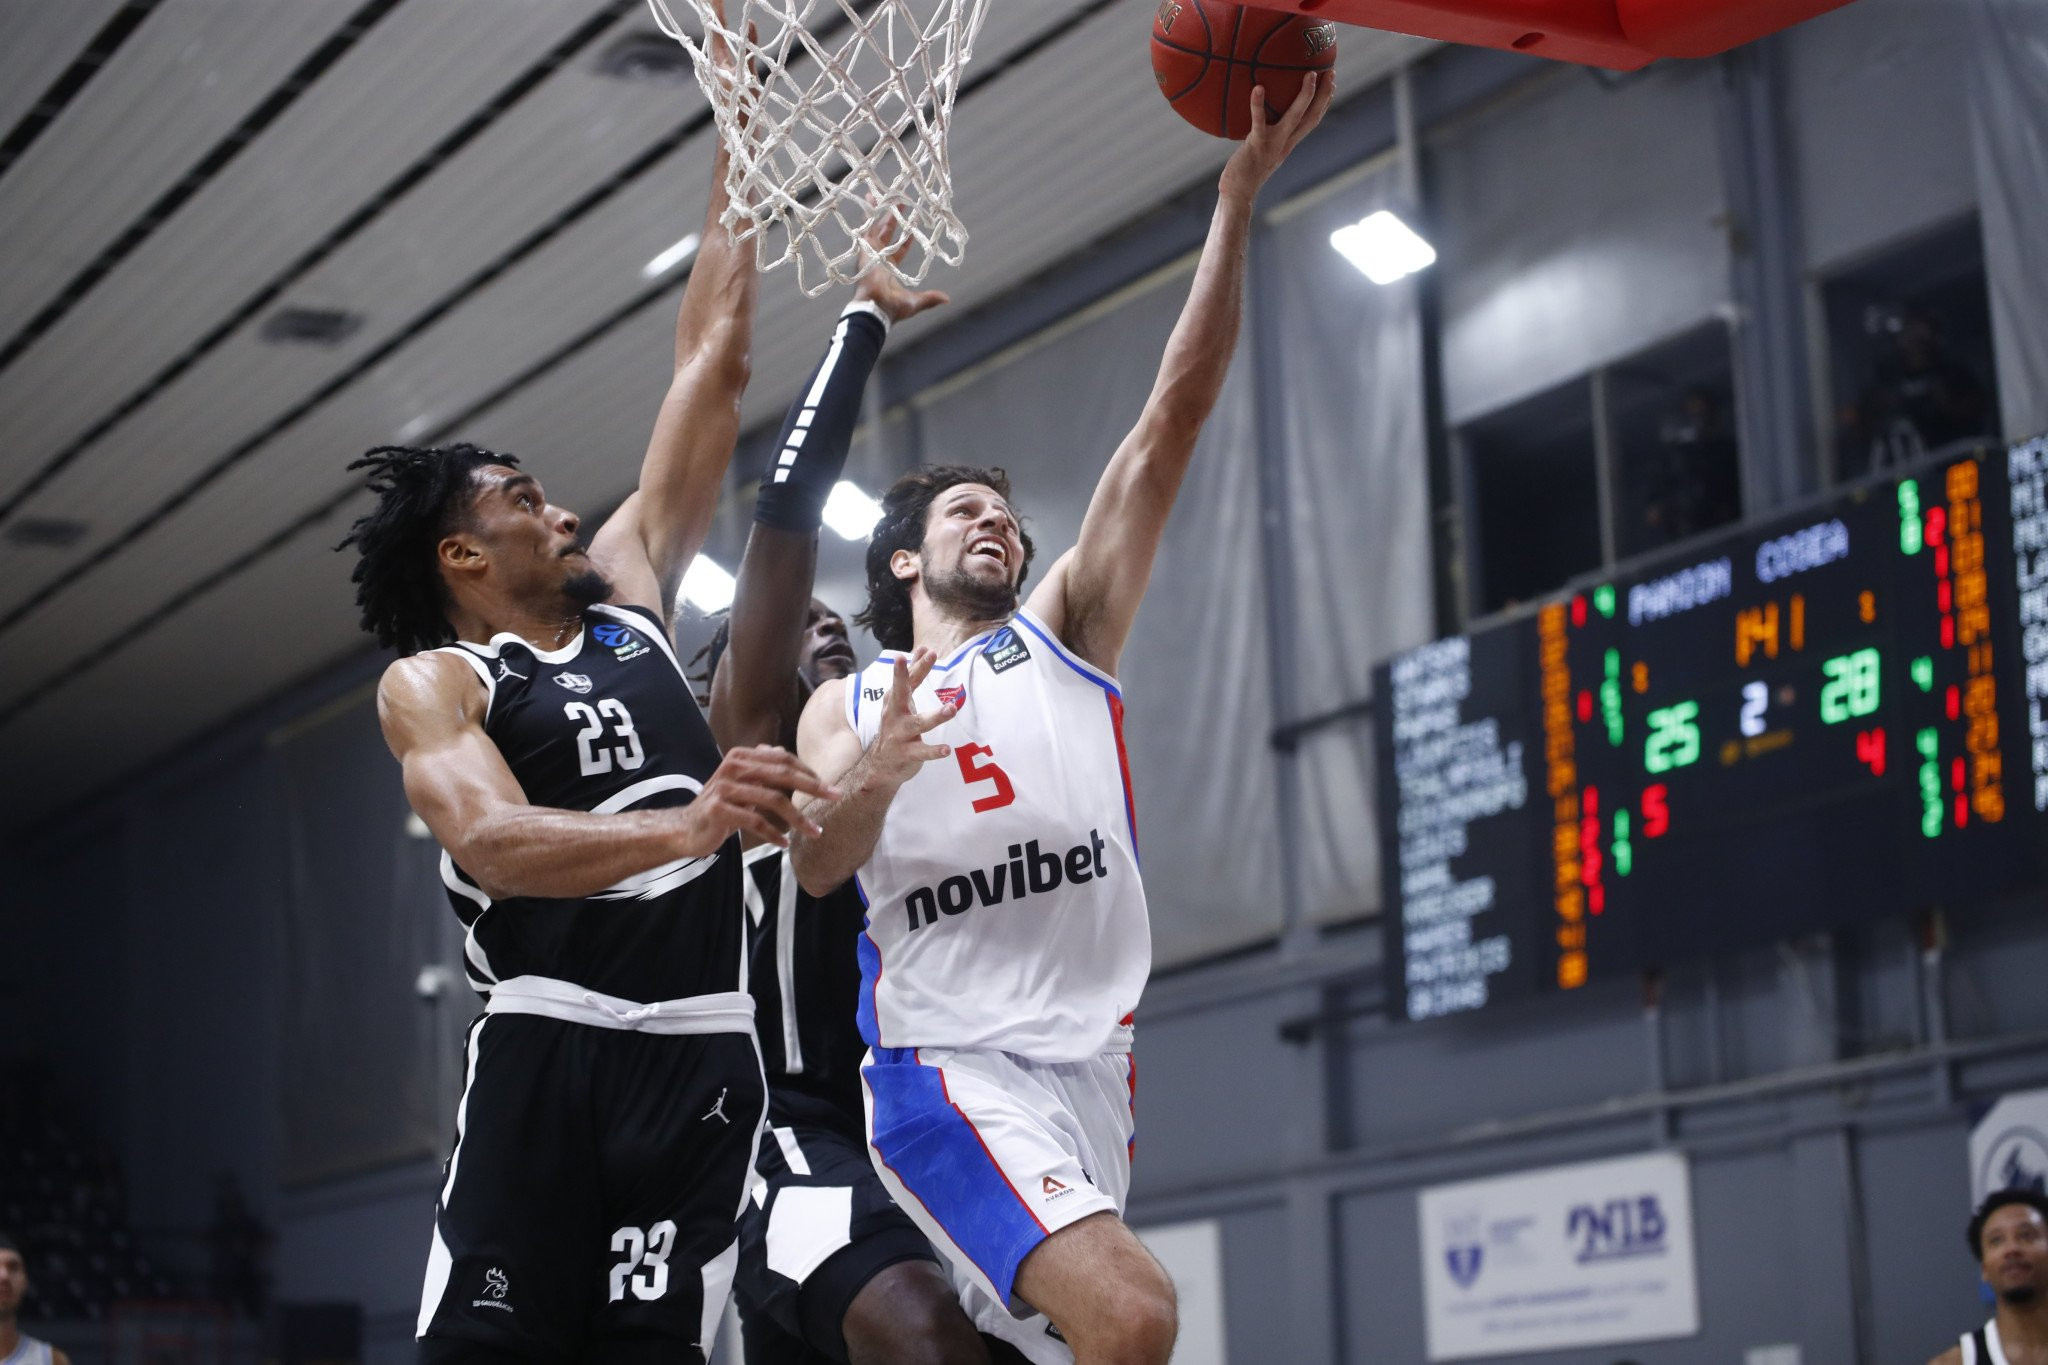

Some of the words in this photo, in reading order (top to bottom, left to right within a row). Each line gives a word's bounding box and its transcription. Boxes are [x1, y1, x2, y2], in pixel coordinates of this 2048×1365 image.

[994, 651, 1028, 670] EuroCup
[1821, 647, 1880, 724] 28
[564, 698, 645, 777] 23
[1645, 700, 1699, 774] 25
[1740, 680, 1768, 737] 2
[954, 741, 1016, 814] 5
[1856, 726, 1886, 777] 4
[1641, 783, 1669, 838] 5
[905, 828, 1107, 932] novibet
[1045, 1187, 1075, 1202] AVAKON
[608, 1219, 677, 1303] 23
